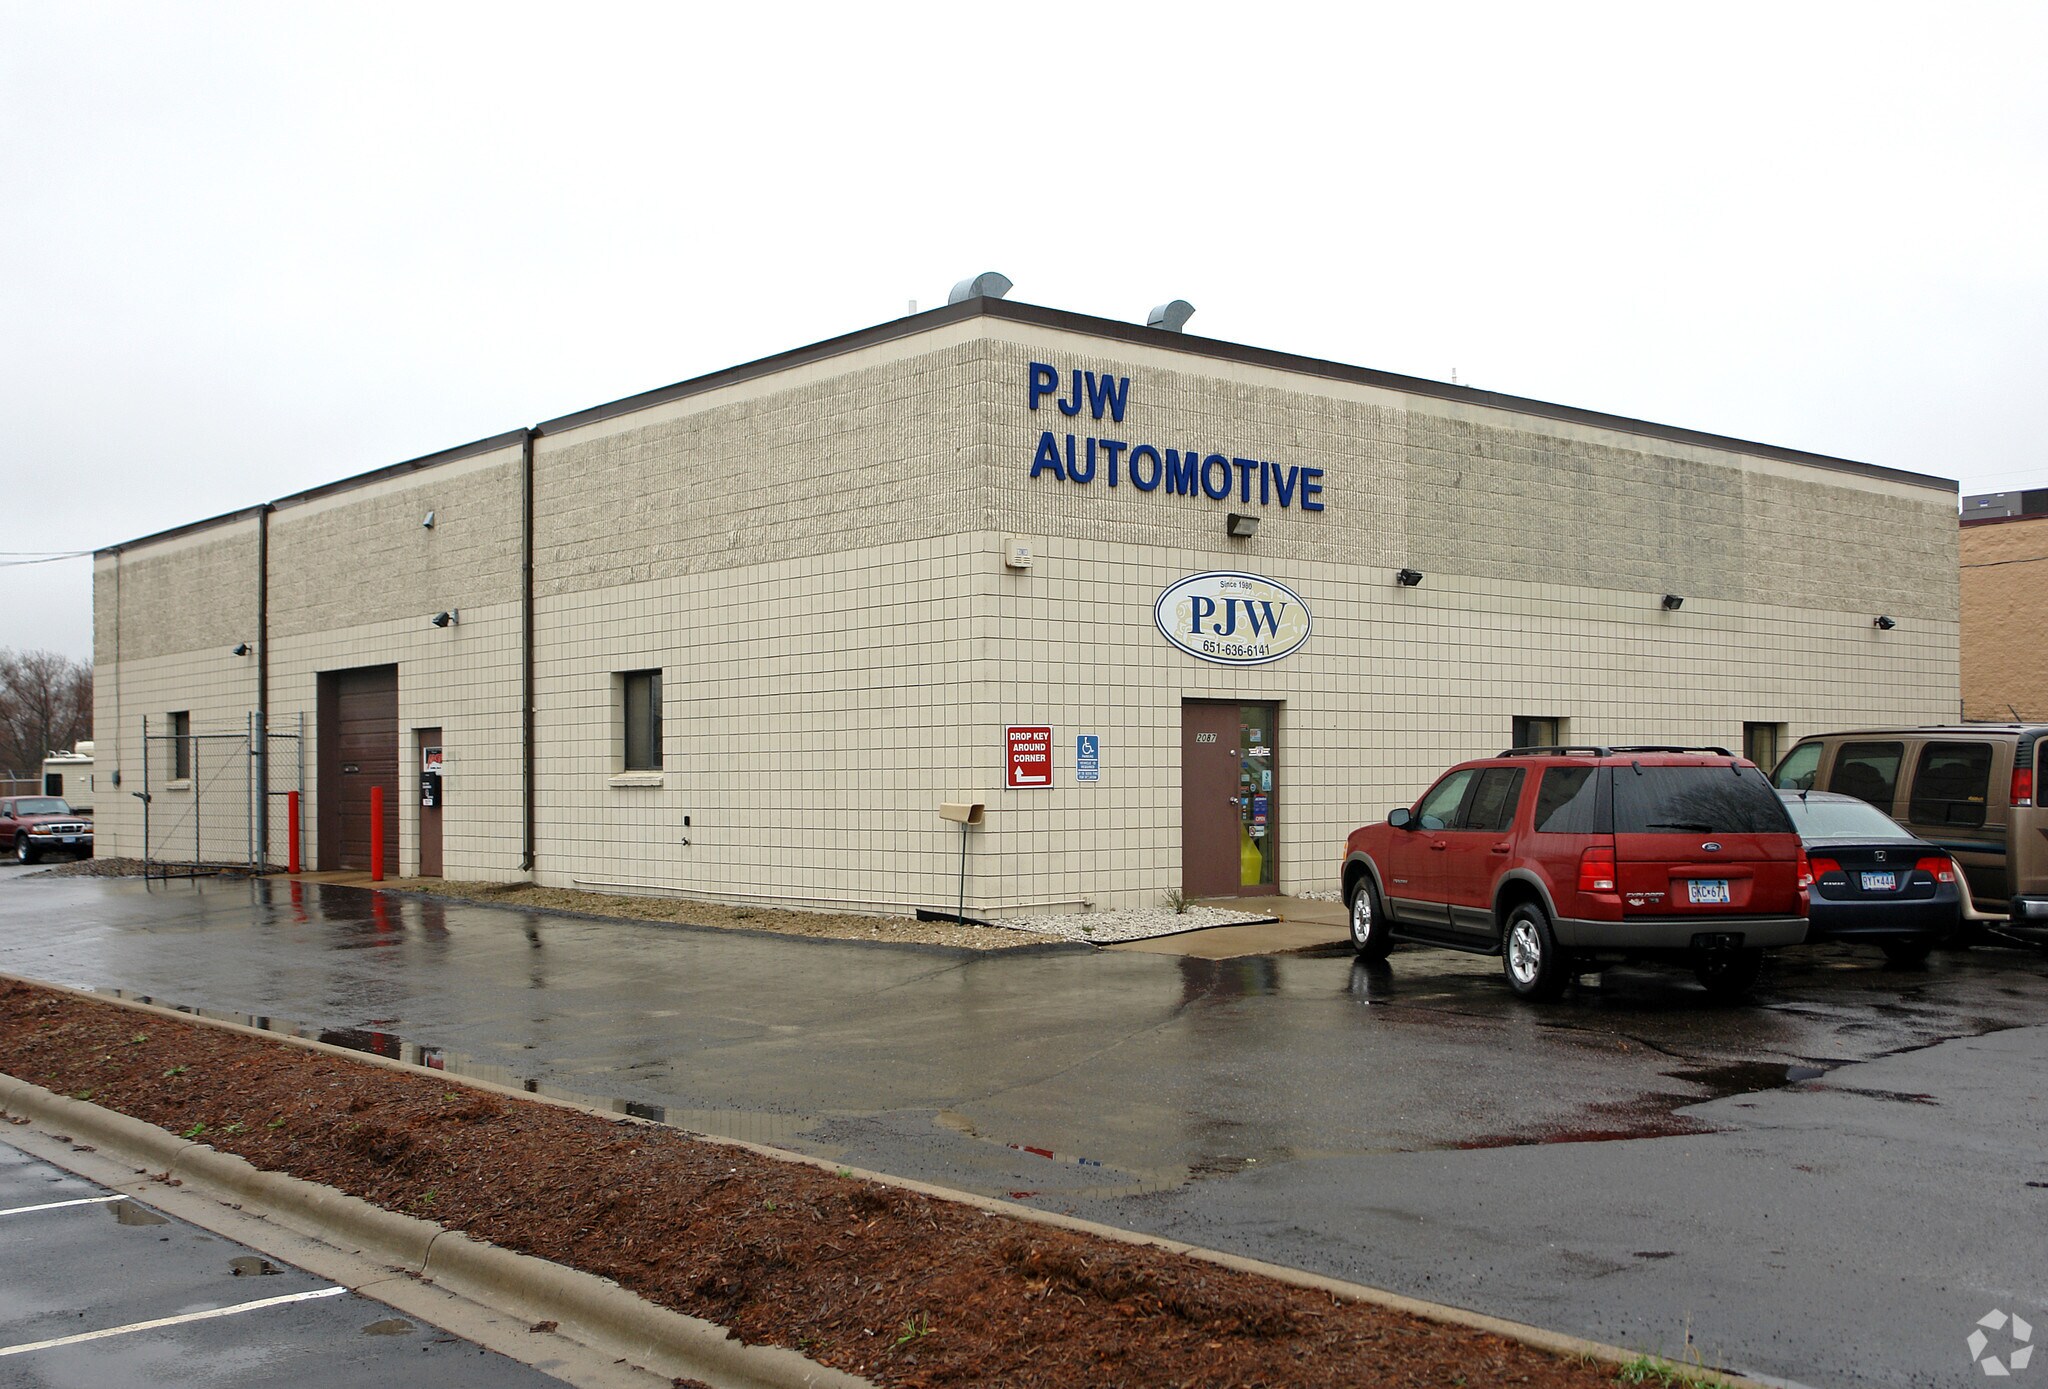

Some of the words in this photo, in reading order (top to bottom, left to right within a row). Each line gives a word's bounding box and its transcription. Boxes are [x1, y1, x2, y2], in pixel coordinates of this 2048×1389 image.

[1029, 361, 1130, 422] PJW
[1030, 431, 1324, 511] AUTOMOTIVE
[1220, 580, 1237, 588] Since
[1187, 595, 1287, 639] PJW
[1203, 640, 1270, 656] 651-636-6141
[1010, 733, 1031, 741] DROP
[1033, 732, 1049, 740] KEY
[1013, 743, 1046, 751] AROUND
[1013, 754, 1046, 762] CORNER
